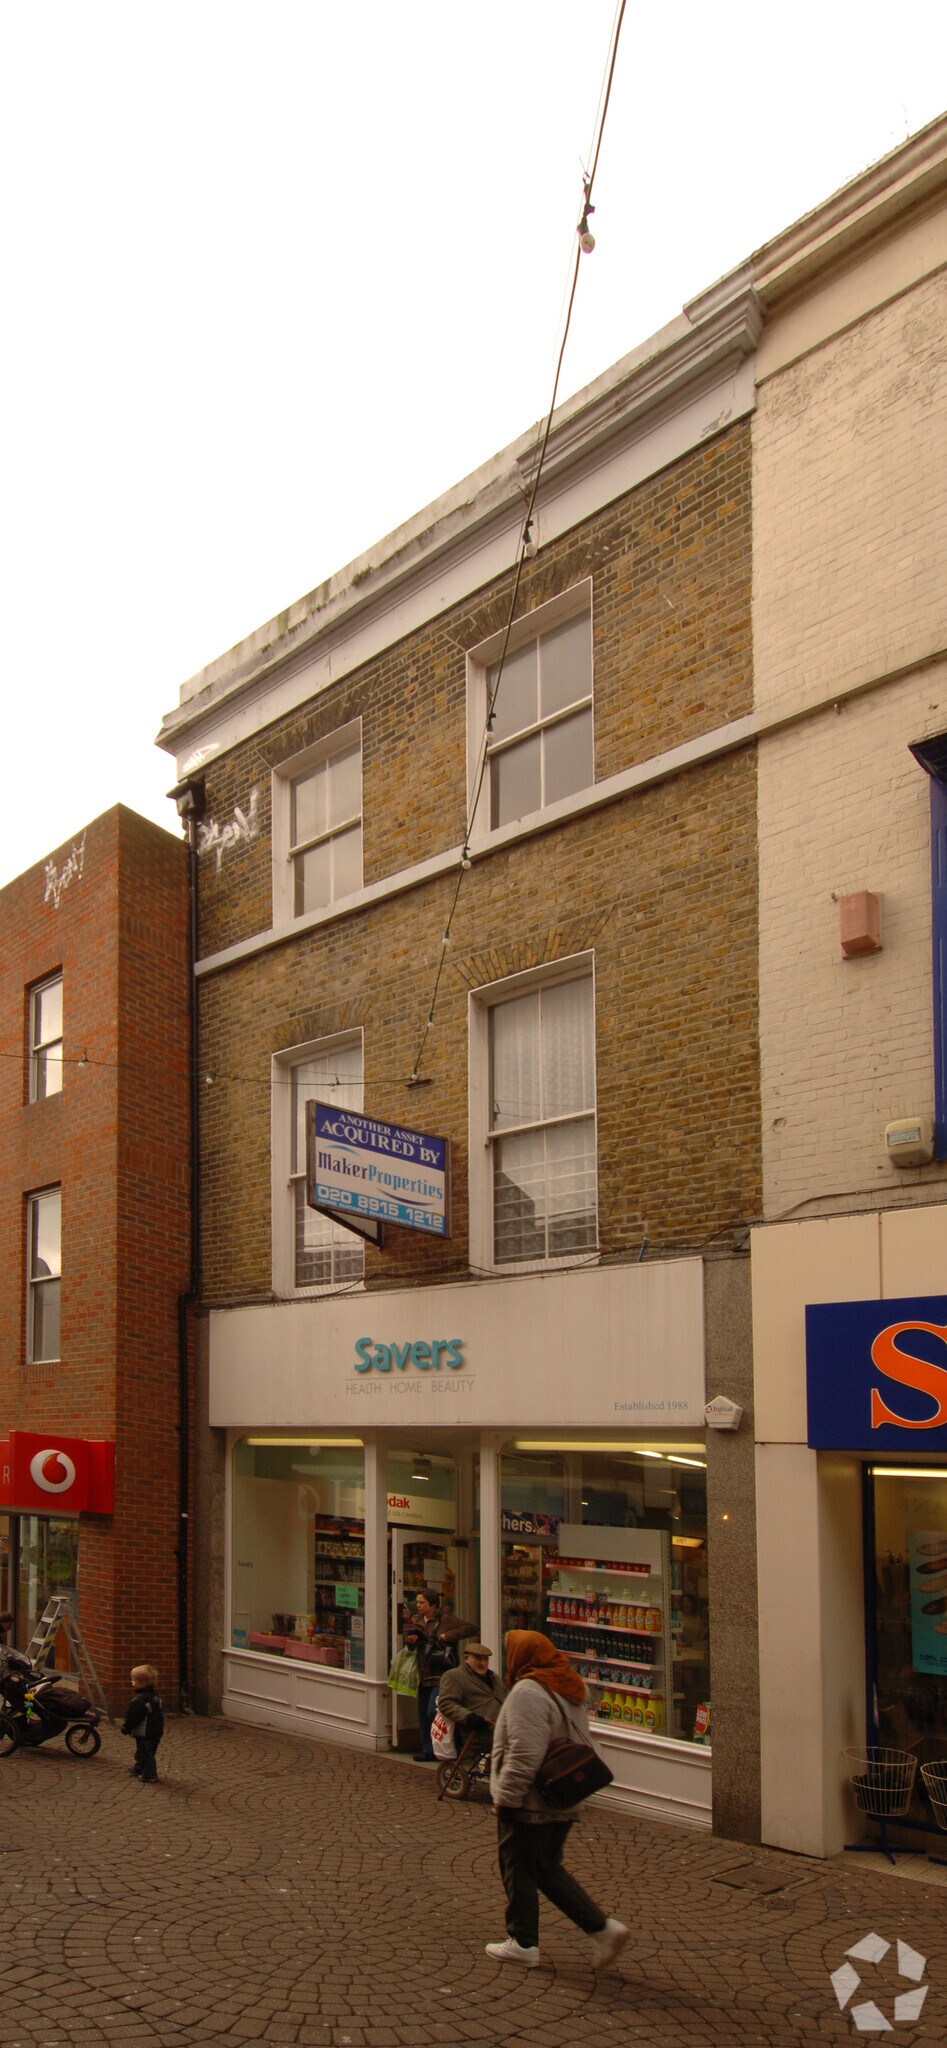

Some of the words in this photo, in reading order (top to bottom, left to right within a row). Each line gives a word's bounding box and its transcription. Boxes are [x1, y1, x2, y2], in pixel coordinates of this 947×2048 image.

[321, 1120, 414, 1157] ACQUIRED
[420, 1147, 440, 1164] BY
[339, 1114, 391, 1136] ANOTHER
[394, 1130, 424, 1145] ASSET
[318, 1185, 352, 1204] 020
[358, 1197, 399, 1217] 8915
[406, 1208, 443, 1228] 1212
[354, 1337, 464, 1371] Savers
[346, 1382, 382, 1395] HEALTH
[390, 1381, 422, 1394] HOME
[431, 1379, 475, 1393] BEAUTY
[614, 1401, 665, 1411] Established
[667, 1400, 689, 1411] 1988
